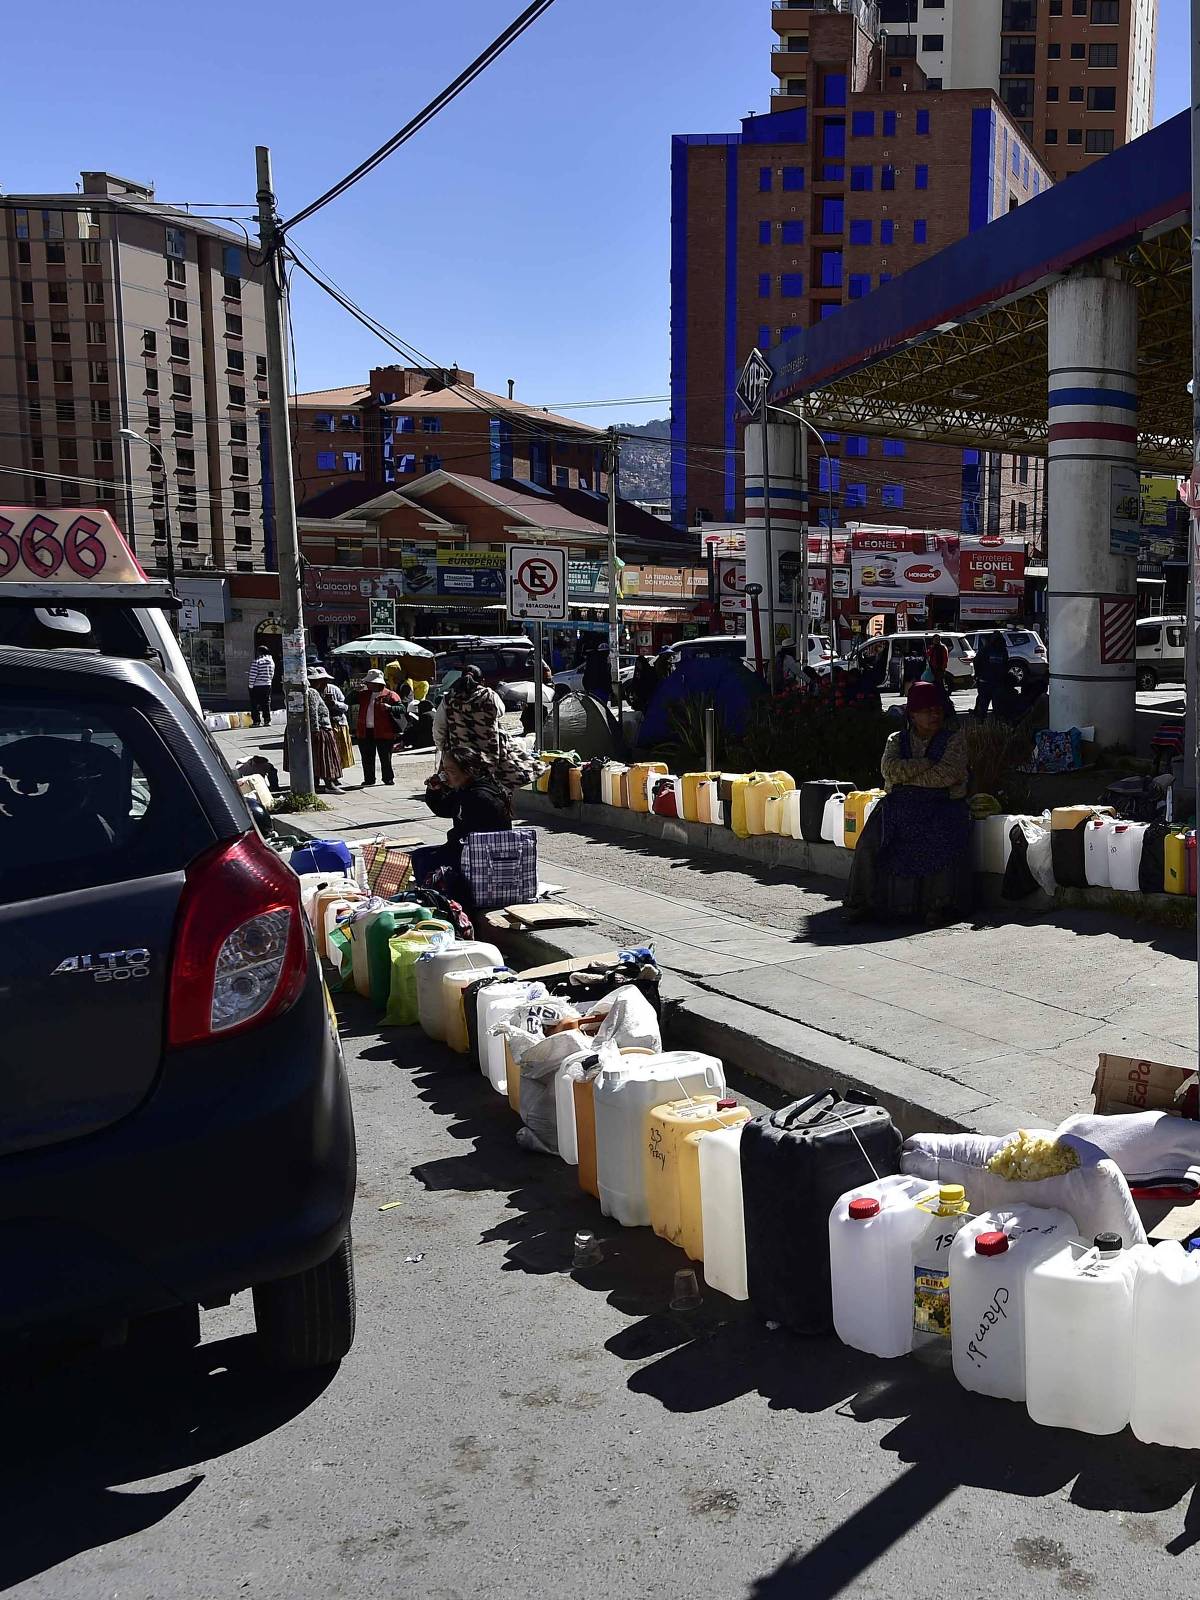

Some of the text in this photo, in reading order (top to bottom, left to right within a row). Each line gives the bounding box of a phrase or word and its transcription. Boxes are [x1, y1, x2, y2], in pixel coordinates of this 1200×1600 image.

[858, 540, 898, 549] LEONEL
[969, 561, 1015, 571] LEONEL
[317, 614, 357, 623] Calacoto
[50, 948, 151, 976] ALTO
[93, 966, 150, 983] 800
